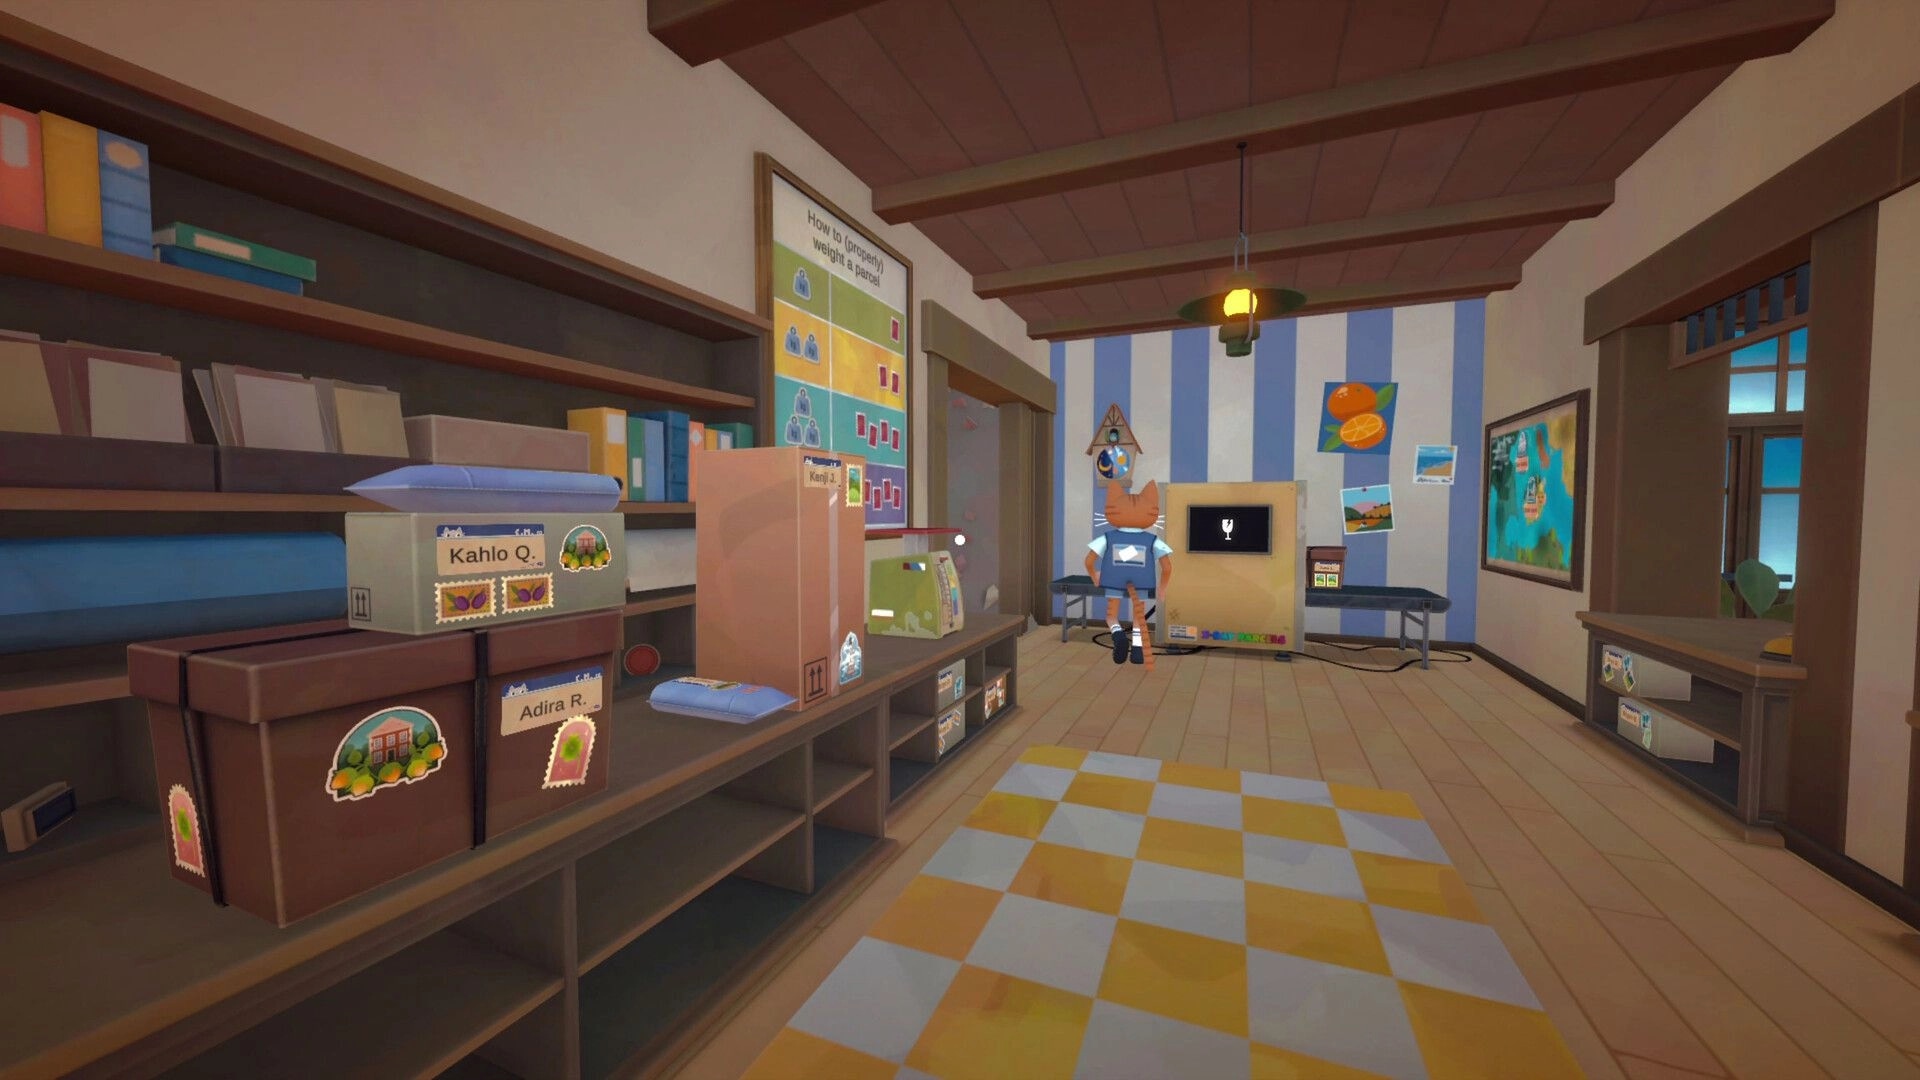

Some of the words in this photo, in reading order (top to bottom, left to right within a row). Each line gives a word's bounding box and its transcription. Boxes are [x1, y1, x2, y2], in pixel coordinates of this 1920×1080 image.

[807, 210, 830, 235] How
[832, 228, 842, 244] to
[845, 235, 883, 274] (properly)
[812, 237, 845, 266] weight
[847, 258, 854, 272] a
[855, 264, 880, 287] parcel
[809, 470, 828, 485] Kenji
[829, 473, 837, 484] J.
[450, 546, 508, 565] Kahlo
[515, 545, 536, 563] Q.
[520, 699, 565, 720] Adira
[570, 693, 587, 708] R.
